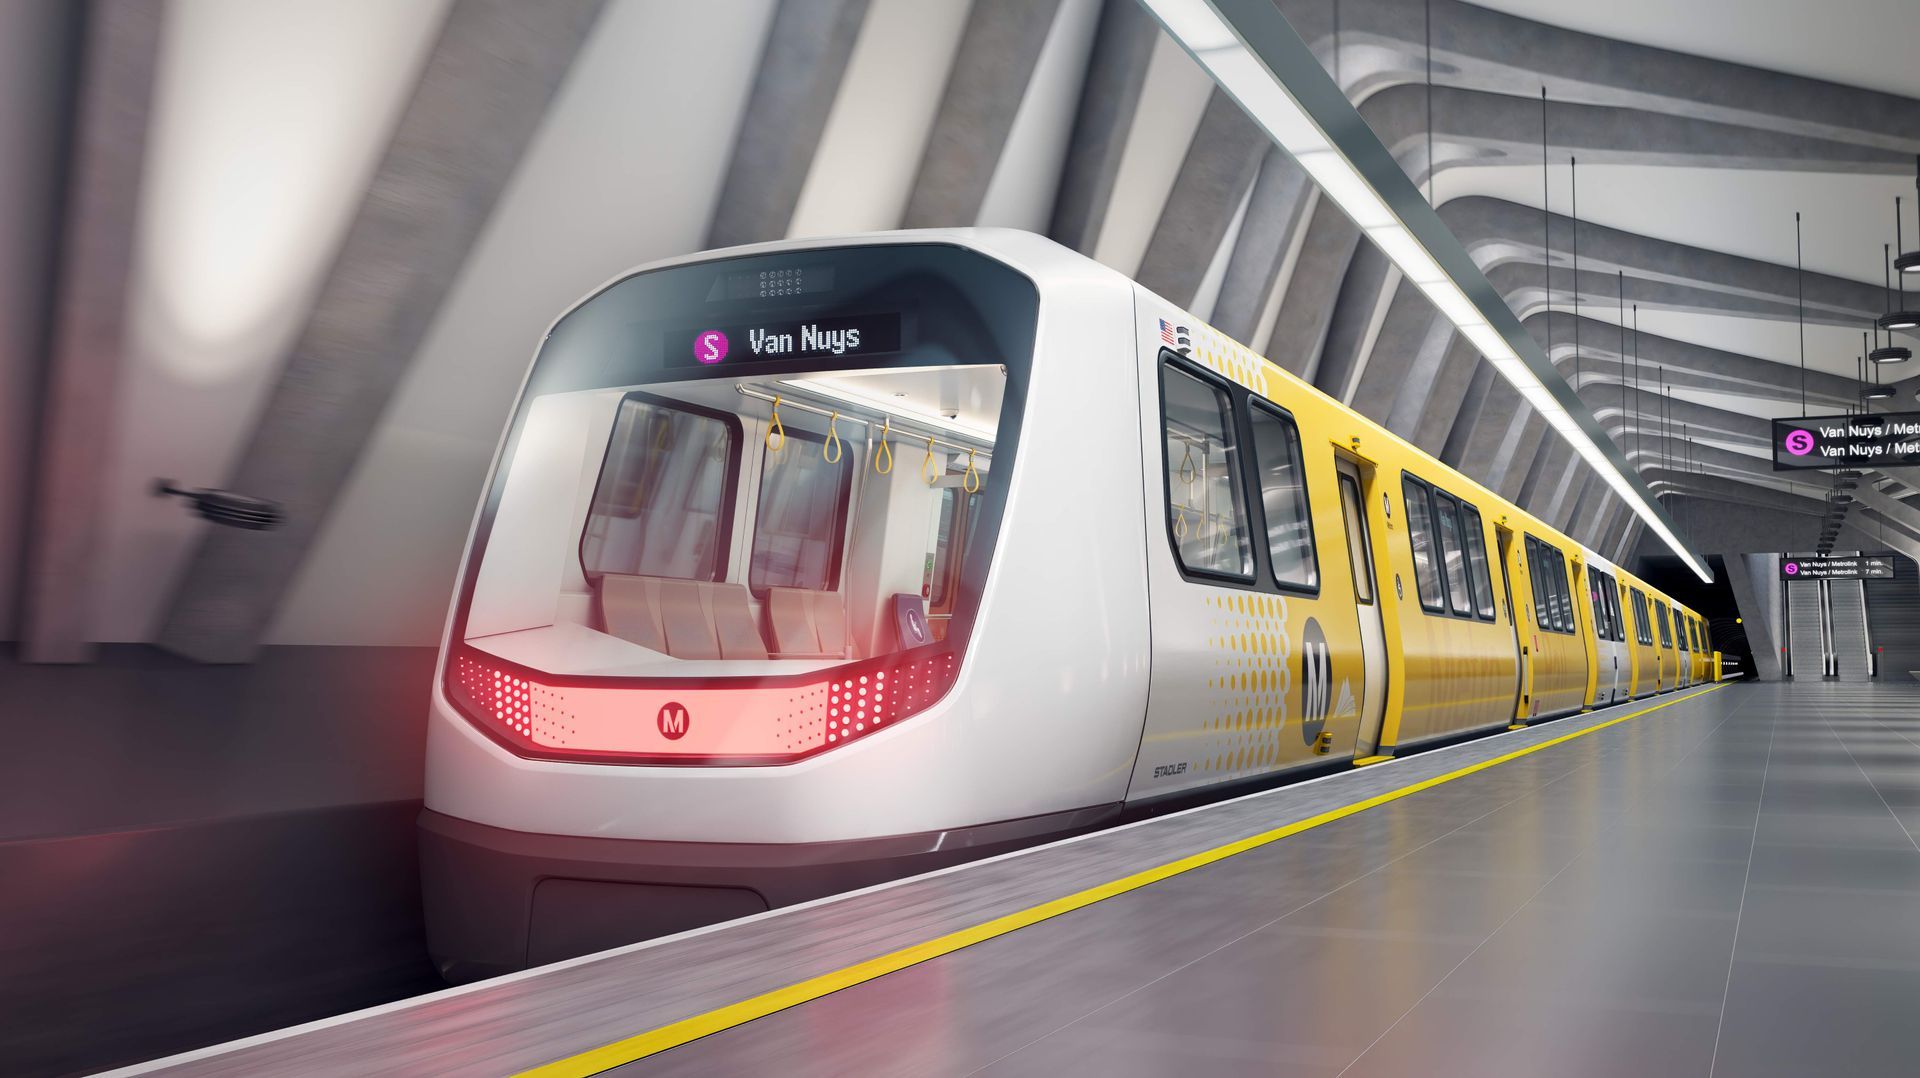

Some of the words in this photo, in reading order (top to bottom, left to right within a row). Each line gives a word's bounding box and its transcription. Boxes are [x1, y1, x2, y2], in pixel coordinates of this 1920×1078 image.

[704, 334, 719, 361] S
[749, 328, 793, 355] Van
[801, 324, 860, 355] Nuys
[1820, 426, 1845, 438] Van
[1849, 425, 1882, 438] Nuys
[1885, 424, 1891, 435] /
[1792, 435, 1808, 451] S
[1820, 445, 1845, 457] Van
[1849, 444, 1883, 457] Nuys
[1886, 443, 1891, 454] /
[1894, 442, 1920, 454] Met
[1305, 641, 1328, 722] M
[663, 709, 684, 734] M
[1153, 762, 1187, 778] STADLER
